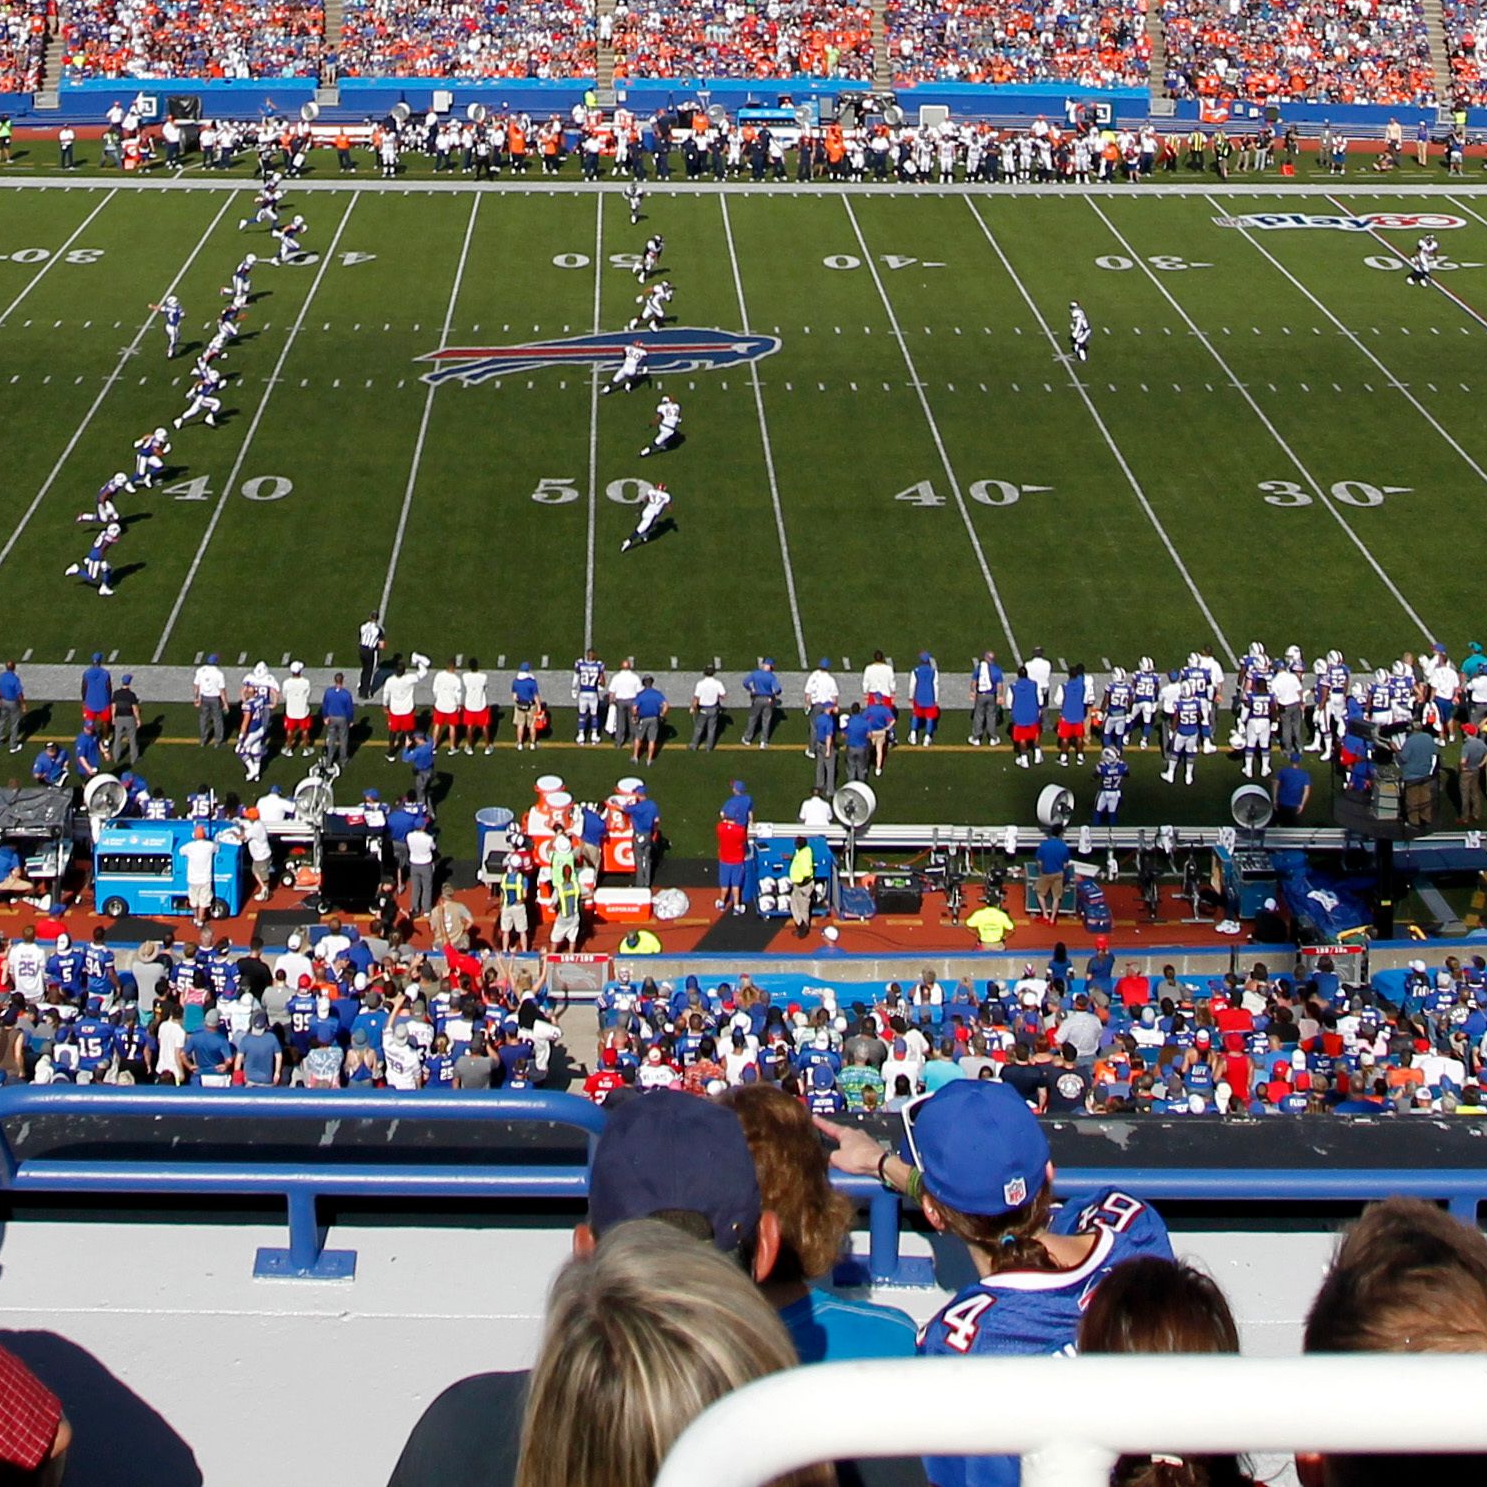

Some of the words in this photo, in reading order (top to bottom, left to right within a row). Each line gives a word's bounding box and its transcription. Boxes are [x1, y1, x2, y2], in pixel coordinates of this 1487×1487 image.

[162, 475, 294, 501] 40
[532, 477, 656, 505] 50
[893, 478, 1021, 507] 40
[1257, 480, 1386, 507] 30
[1253, 701, 1270, 716] 91
[1373, 693, 1390, 708] 21
[1178, 710, 1198, 725] 55
[192, 801, 211, 816] 15
[613, 841, 635, 867] G
[62, 966, 73, 983] 5
[85, 960, 103, 978] 94
[78, 1037, 102, 1058] 15
